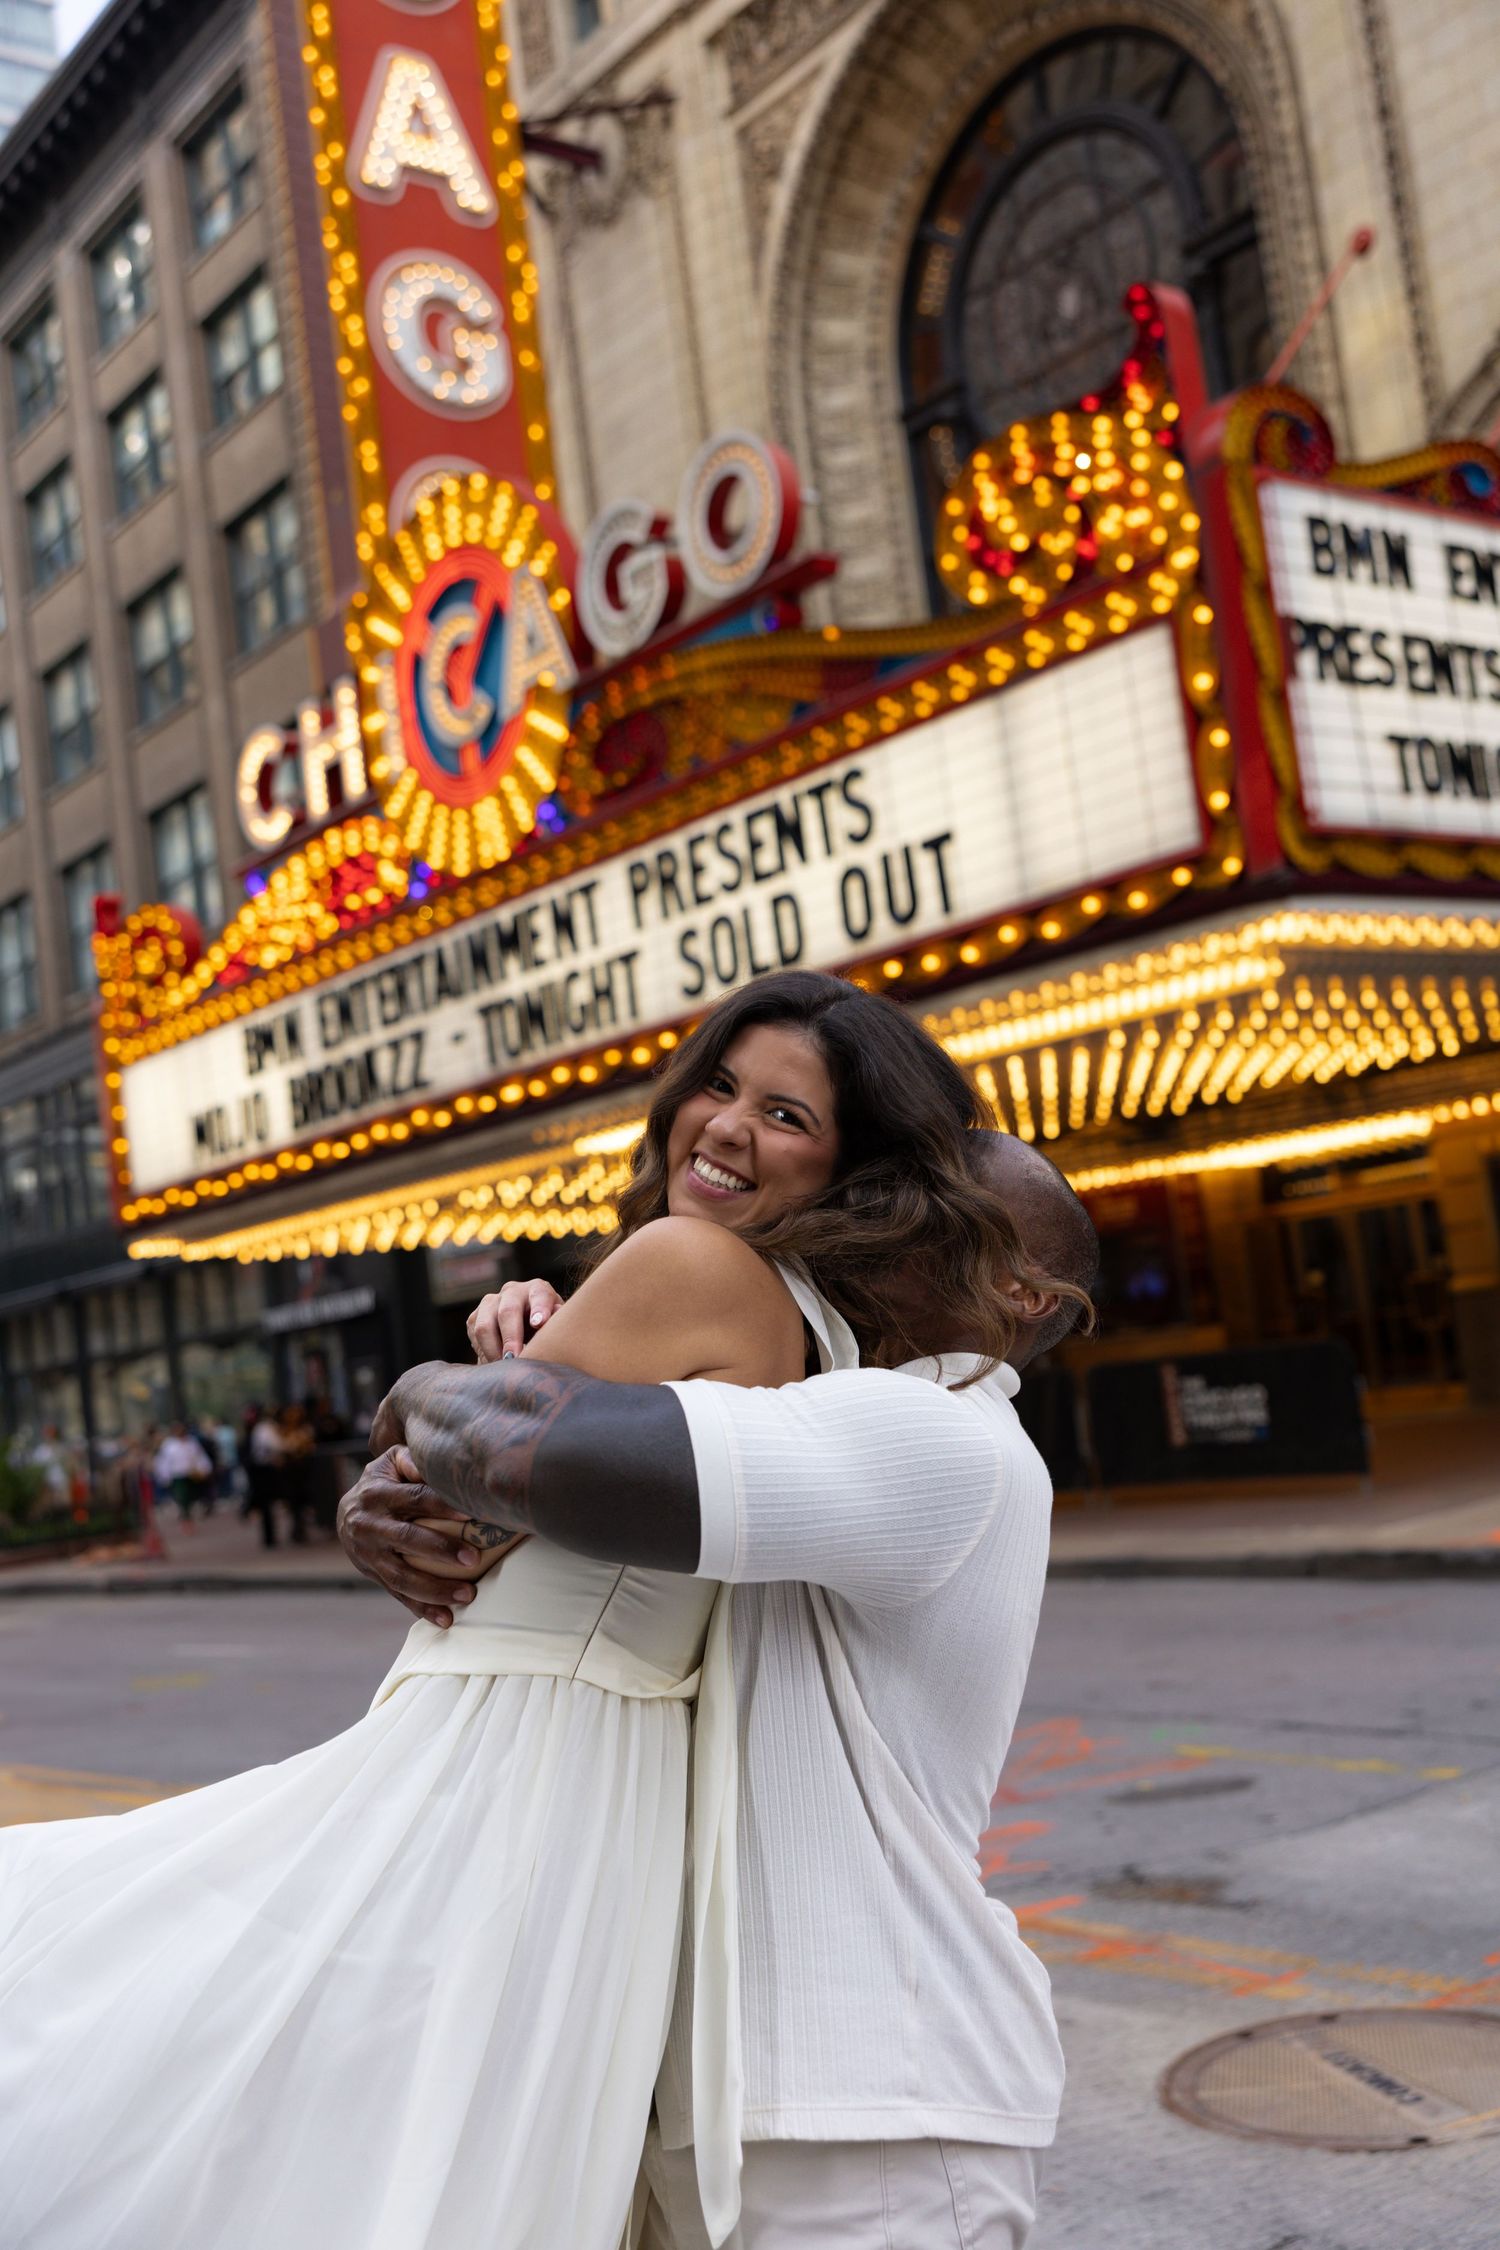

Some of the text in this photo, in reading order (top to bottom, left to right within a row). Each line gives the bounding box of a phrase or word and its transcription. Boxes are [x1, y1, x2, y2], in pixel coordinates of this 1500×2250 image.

[1308, 515, 1414, 591] BMN
[1288, 616, 1500, 701] PRESENTS
[1386, 734, 1500, 799] TONI
[244, 768, 874, 1077] BMN ENTERTAINMENT PRESENTS
[479, 950, 638, 1065] TONIGHT
[678, 892, 802, 997] SOLD
[839, 831, 954, 941] OUT
